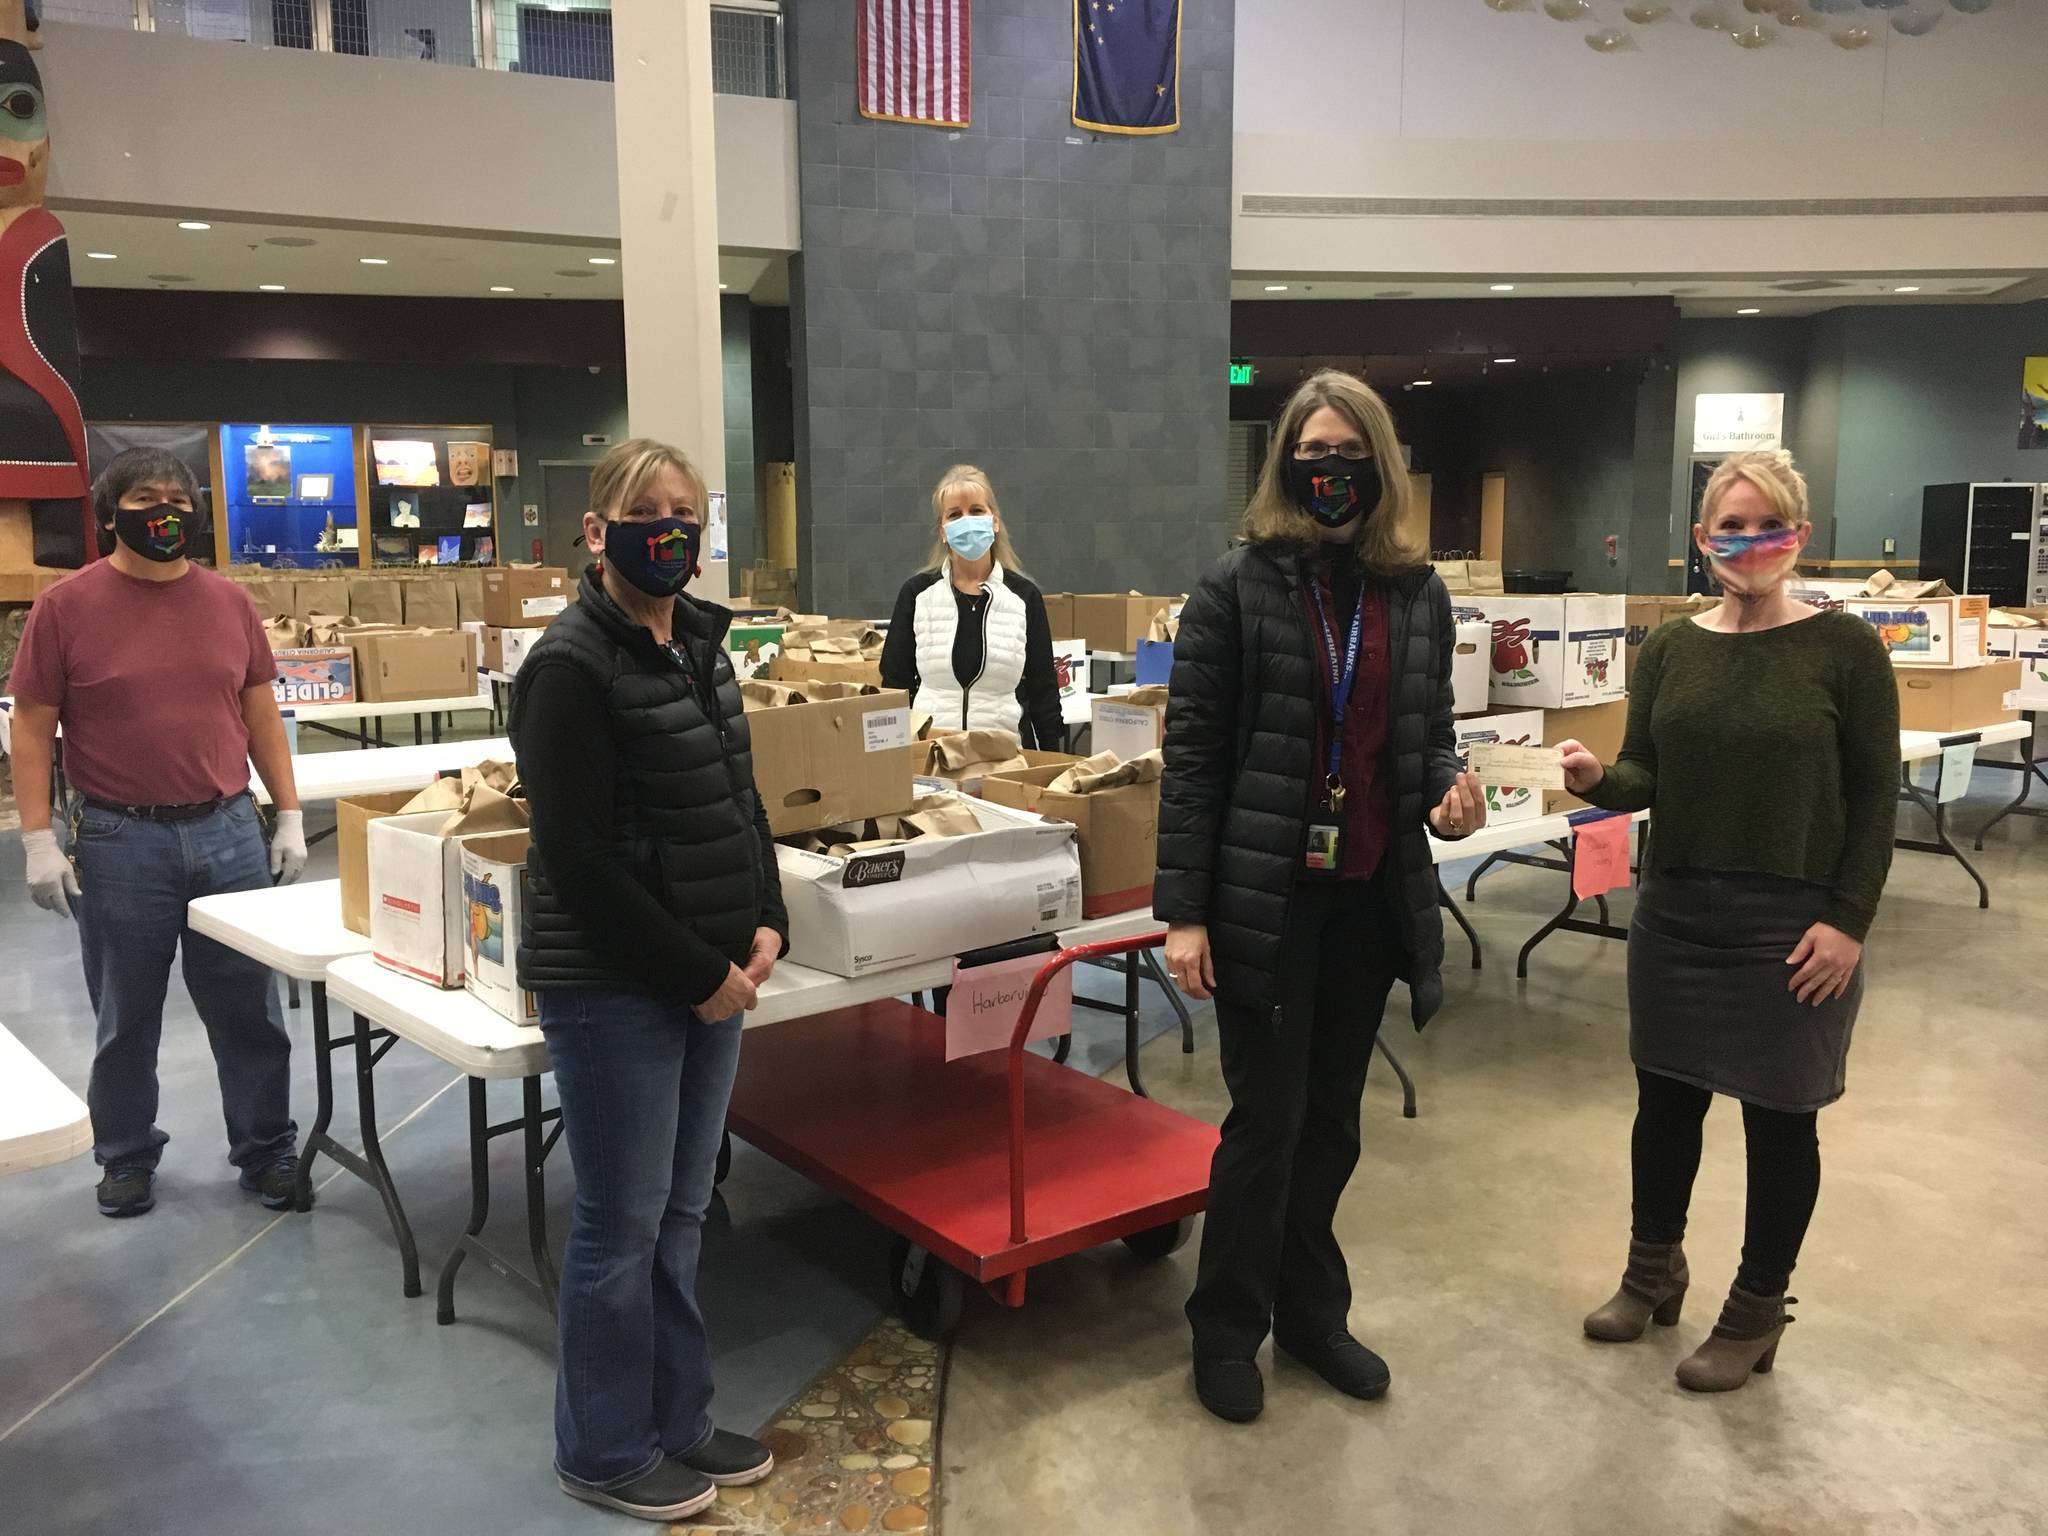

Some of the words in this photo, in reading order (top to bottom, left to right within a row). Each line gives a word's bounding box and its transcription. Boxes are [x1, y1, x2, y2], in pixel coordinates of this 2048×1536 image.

[1729, 431, 1776, 441] Bathroom
[271, 682, 344, 702] GLIDER
[849, 859, 900, 883] Baker's
[972, 983, 1049, 1015] Harborvi
